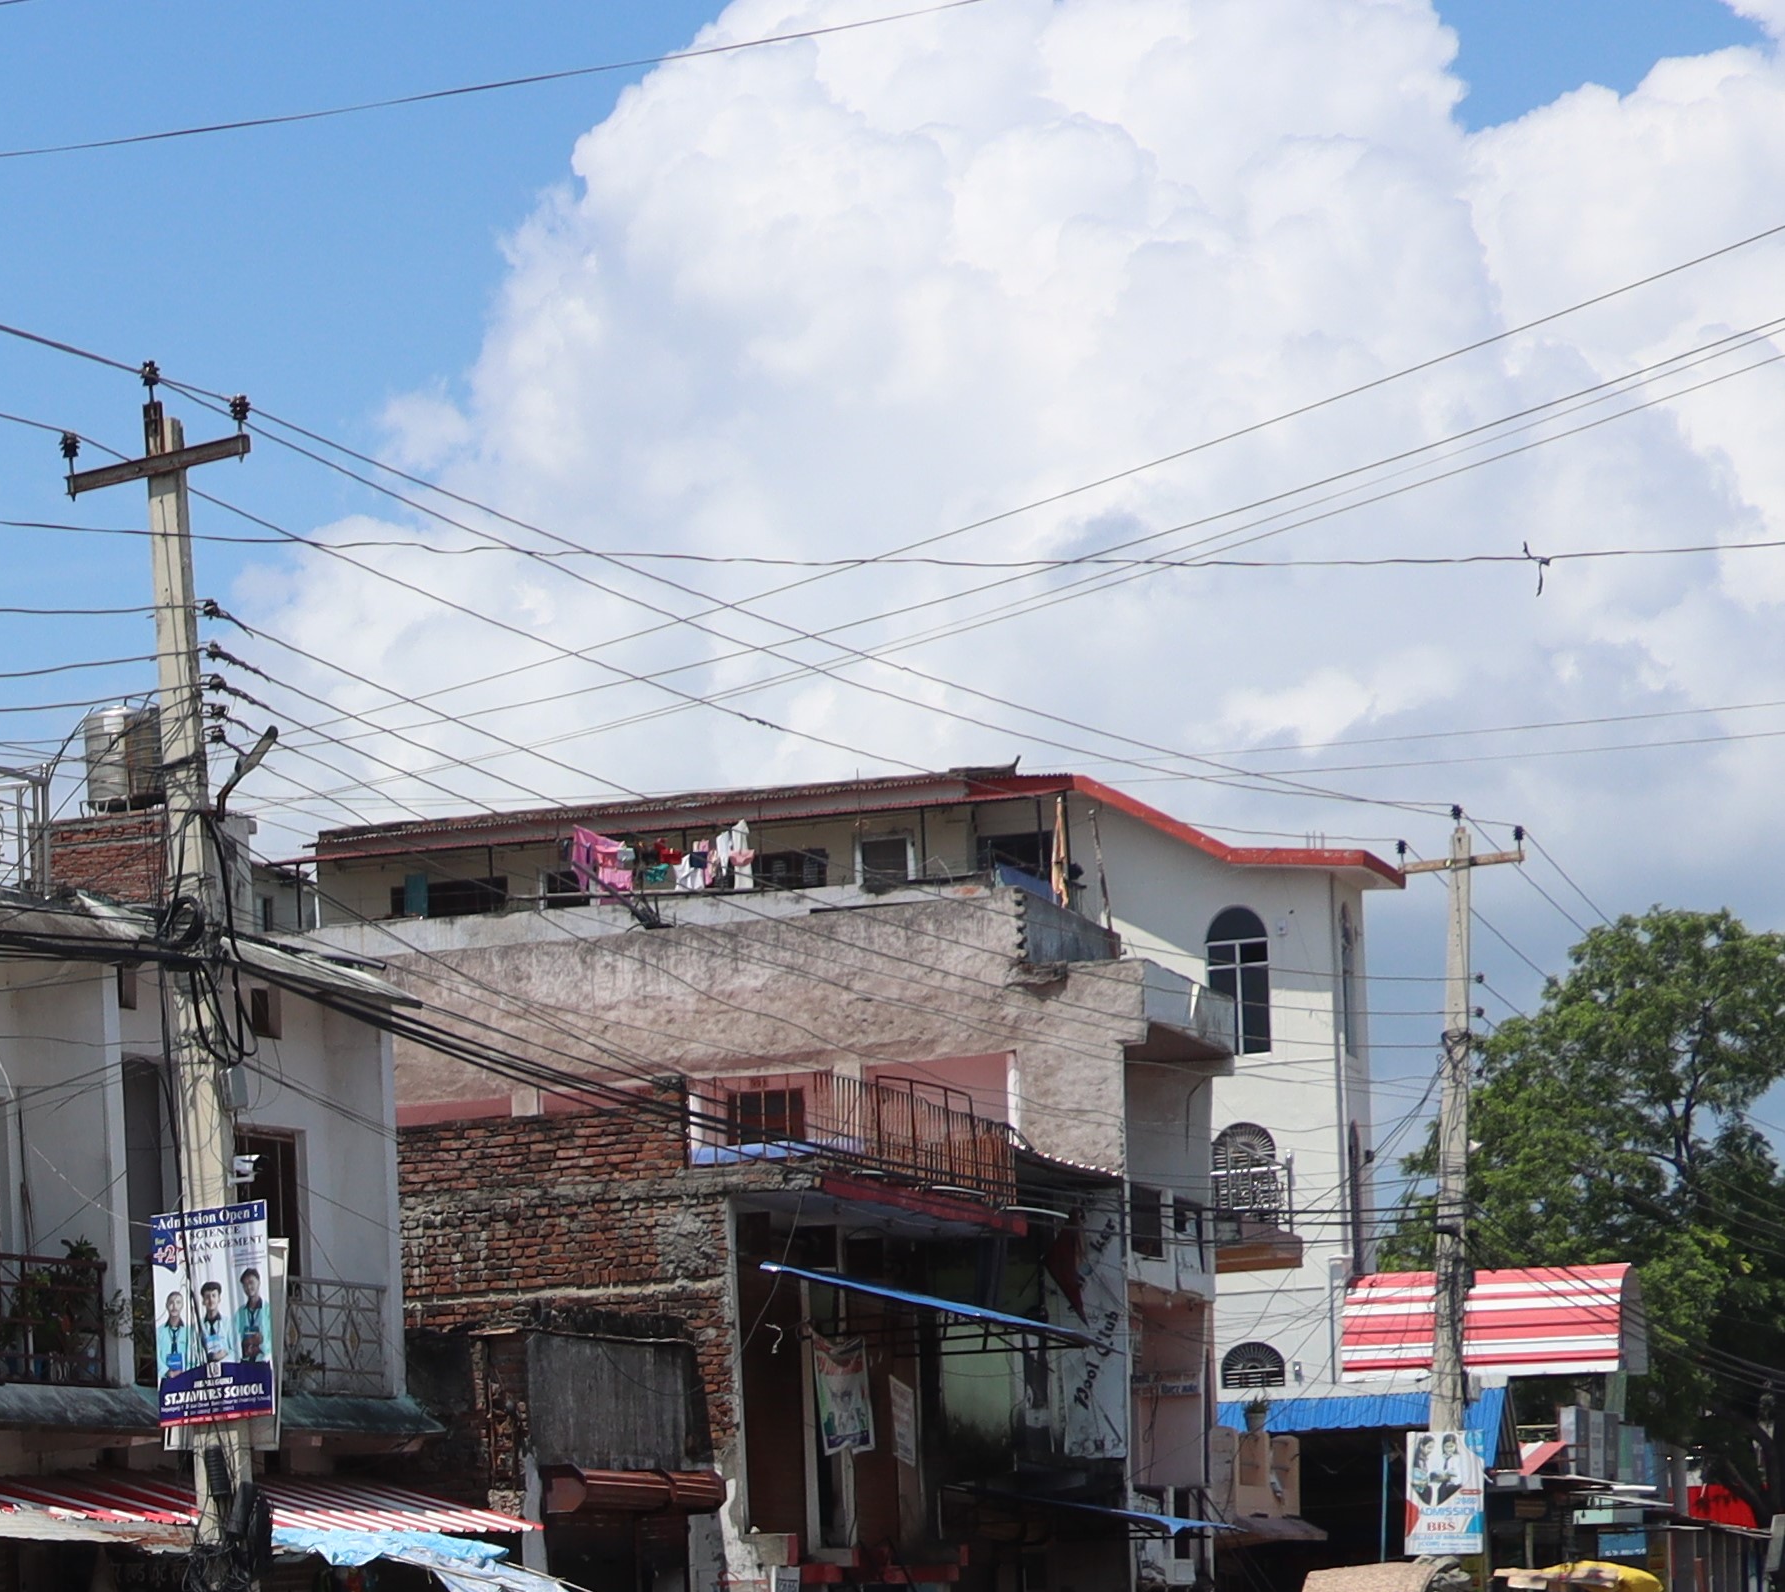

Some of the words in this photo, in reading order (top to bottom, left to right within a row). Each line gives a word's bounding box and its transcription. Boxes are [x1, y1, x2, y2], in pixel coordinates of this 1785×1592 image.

[219, 1208, 250, 1224] Open
[223, 1382, 265, 1399] SCHOOL
[1426, 1521, 1456, 1532] BBS
